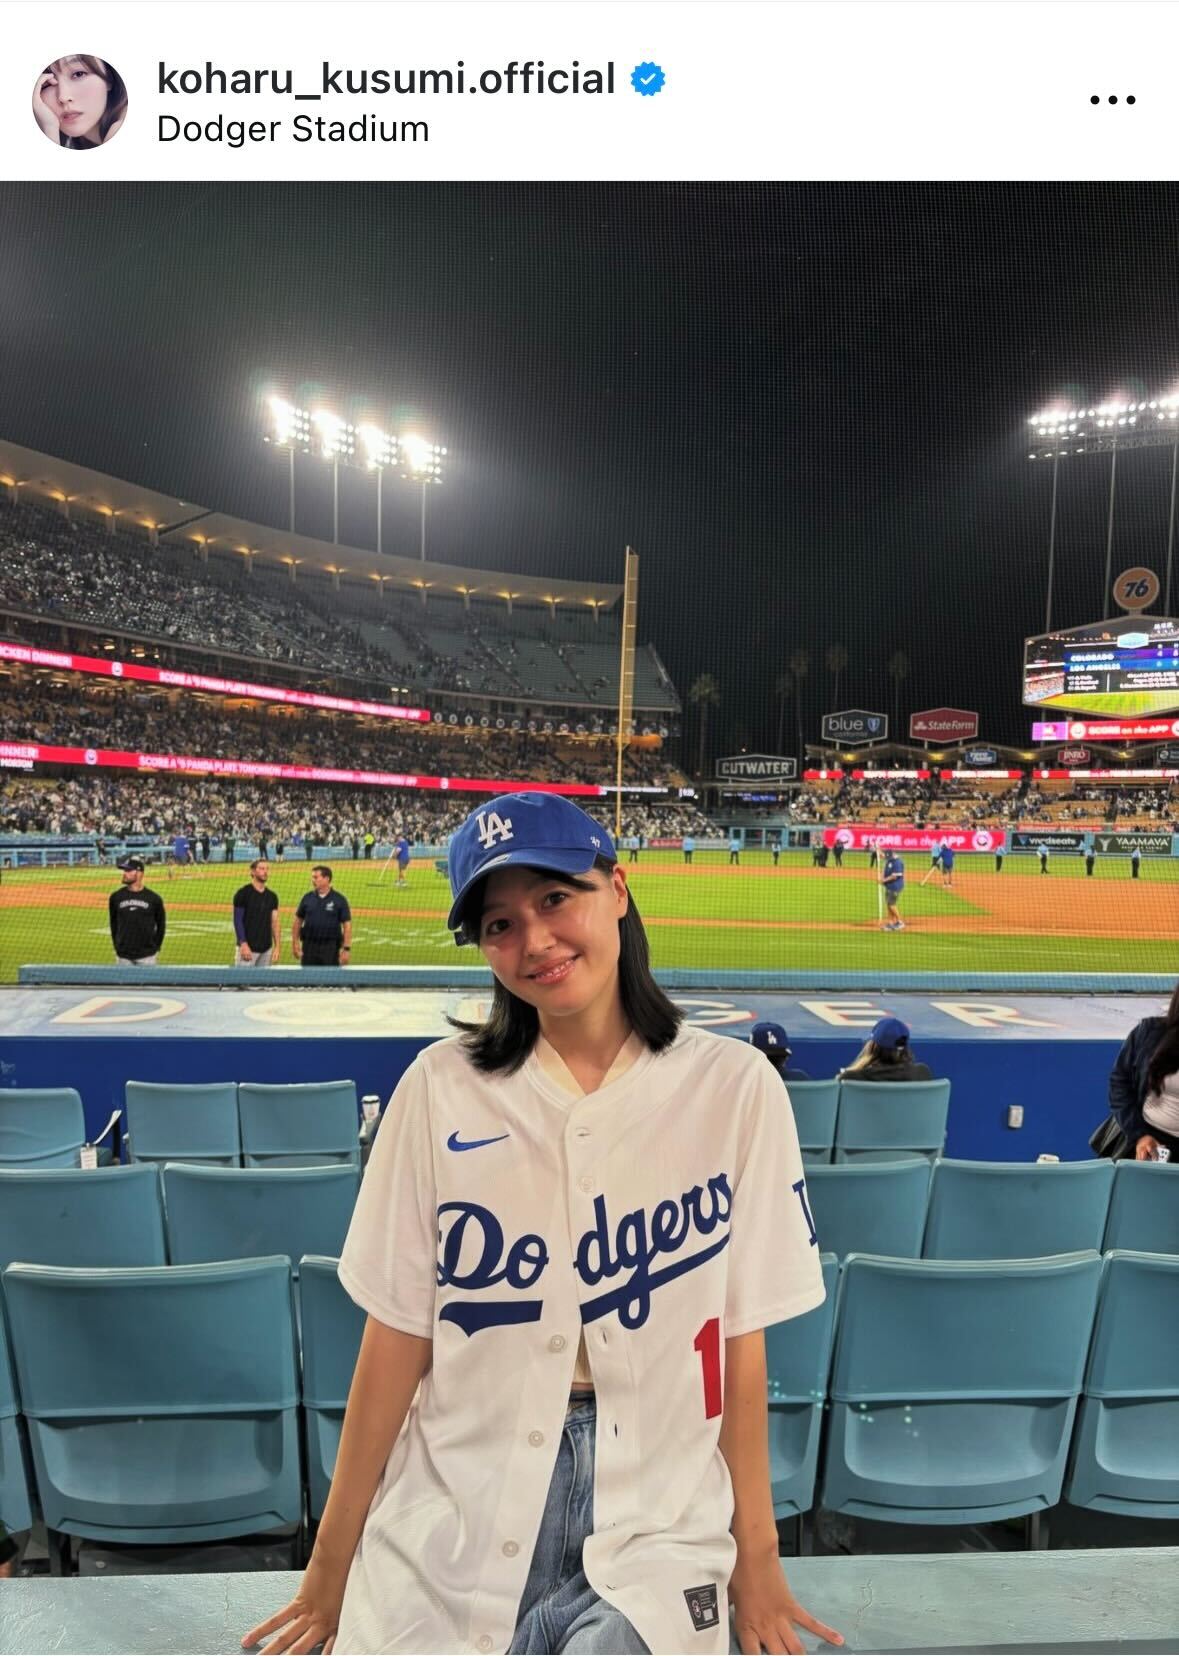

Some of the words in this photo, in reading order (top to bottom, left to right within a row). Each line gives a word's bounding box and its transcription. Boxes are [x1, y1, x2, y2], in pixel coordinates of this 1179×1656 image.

[1124, 578, 1149, 598] 76
[1070, 653, 1114, 662] COLORADO
[1069, 663, 1085, 672] LOS
[1086, 662, 1121, 671] ANGELES
[828, 717, 864, 732] blue
[1149, 723, 1169, 734] APP
[721, 761, 789, 775] CUTWATER
[475, 811, 514, 849] LA
[861, 833, 902, 847] SCORE
[903, 837, 917, 847] on
[919, 833, 938, 848] the
[938, 835, 965, 847] APP
[437, 1172, 732, 1331] Dodgers
[693, 1317, 722, 1420] 1
